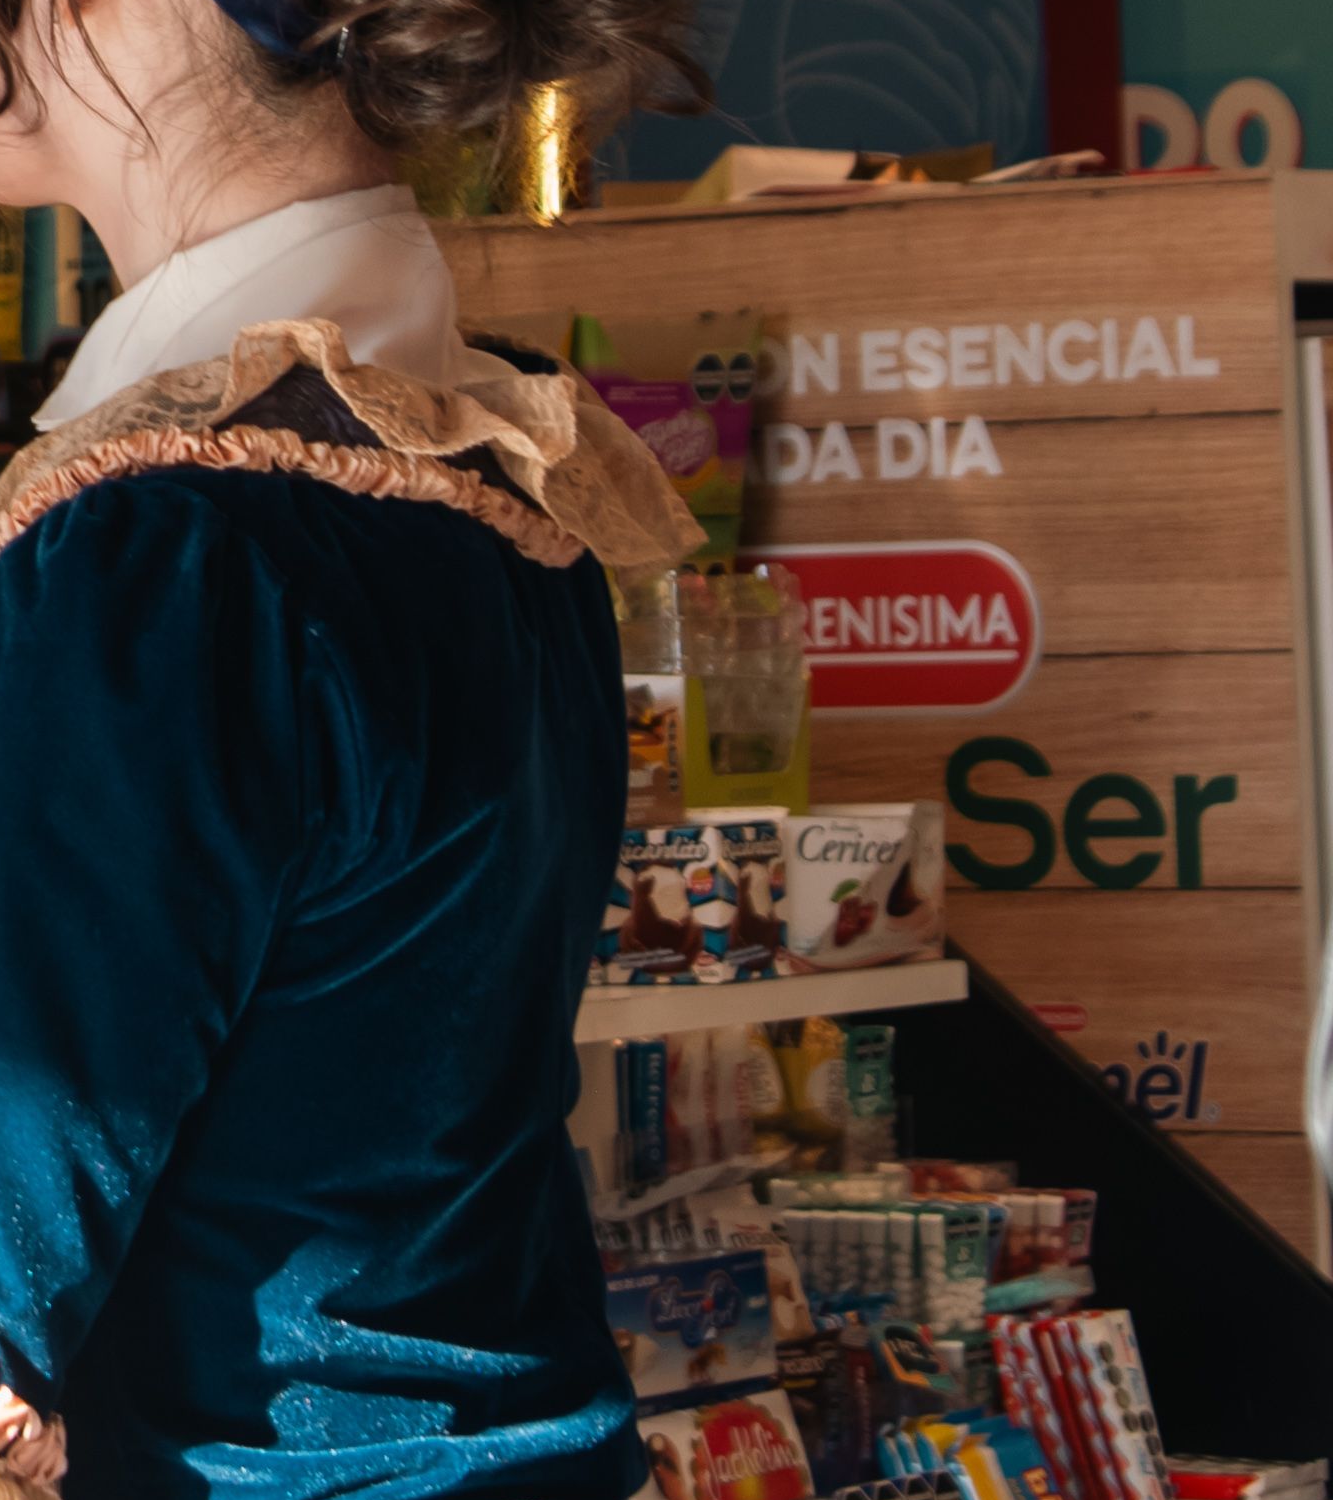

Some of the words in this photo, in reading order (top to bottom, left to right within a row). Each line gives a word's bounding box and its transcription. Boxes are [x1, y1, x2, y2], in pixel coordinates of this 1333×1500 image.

[859, 314, 1221, 393] ESENCIAL
[876, 414, 1004, 481] DIA
[944, 734, 1237, 892] Ser
